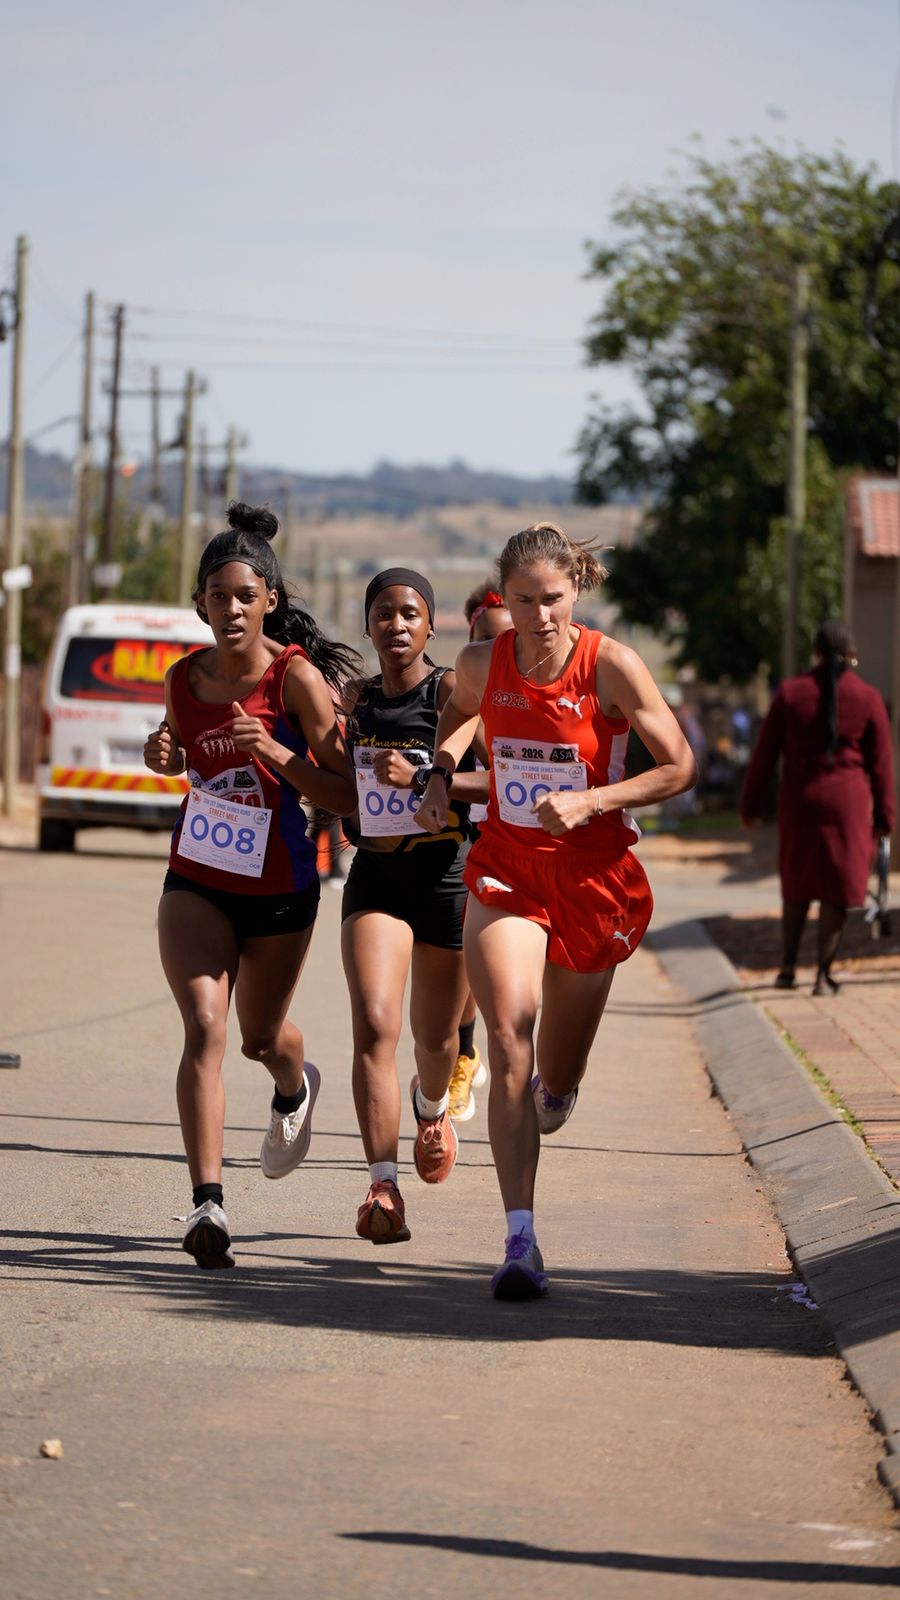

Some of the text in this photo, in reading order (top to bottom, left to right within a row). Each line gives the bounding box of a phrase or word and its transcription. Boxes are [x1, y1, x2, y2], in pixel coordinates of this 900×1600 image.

[521, 747, 544, 759] 2026
[521, 772, 540, 780] STREET
[209, 807, 238, 822] STREET MILE
[190, 814, 255, 854] 008
